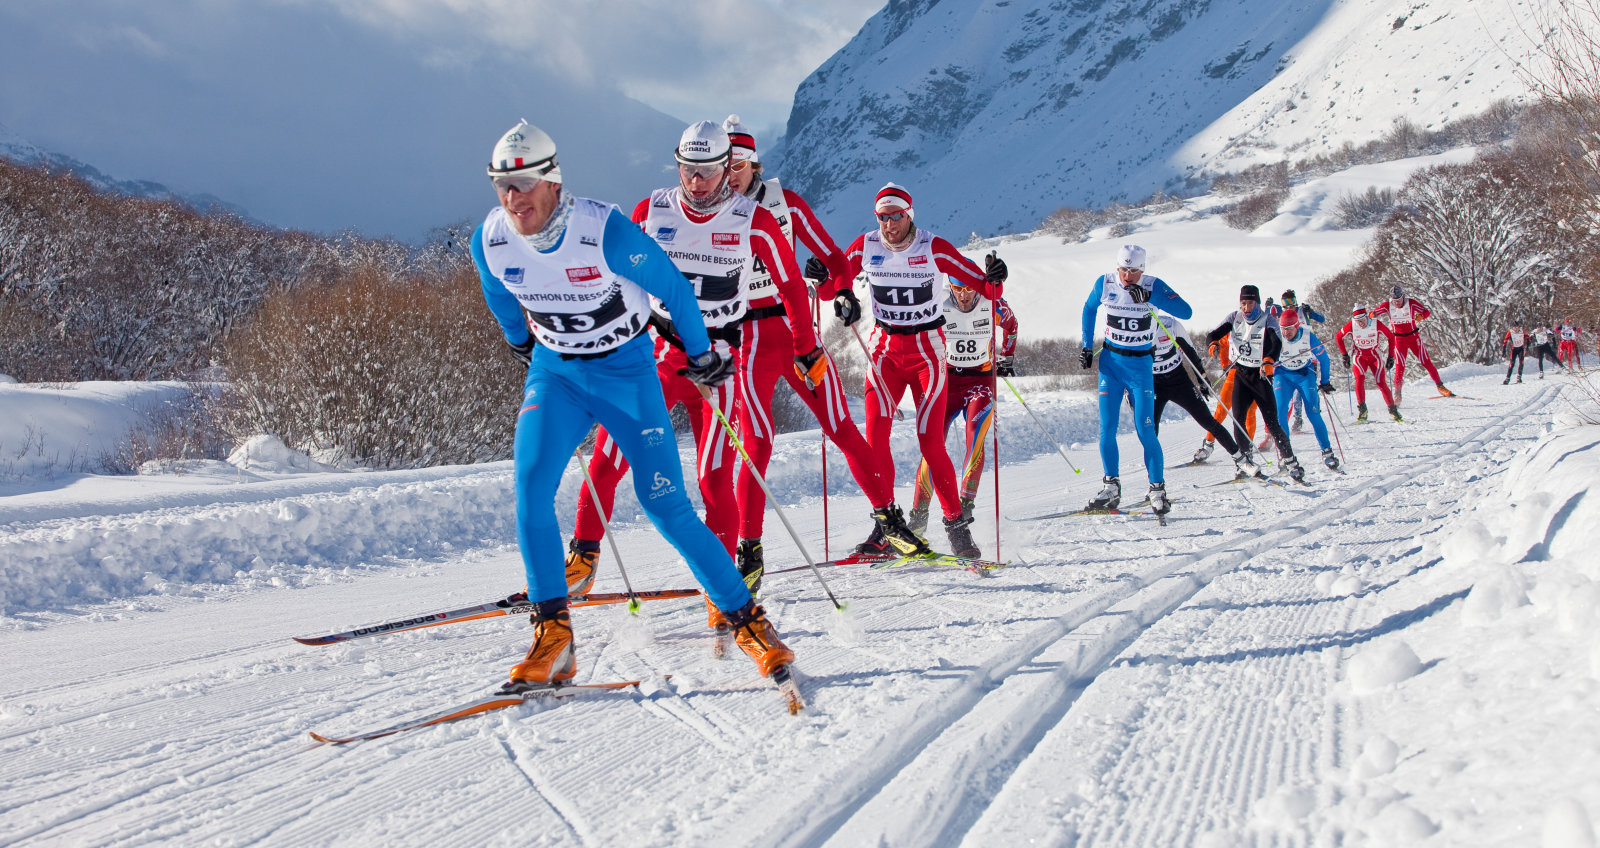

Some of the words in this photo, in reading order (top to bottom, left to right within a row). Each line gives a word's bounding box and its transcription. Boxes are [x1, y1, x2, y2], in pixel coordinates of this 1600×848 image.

[664, 250, 700, 262] ARATHON
[701, 254, 712, 263] DE
[563, 294, 577, 302] DE
[886, 288, 915, 305] 11
[881, 304, 938, 321] BESSANS
[1117, 318, 1139, 331] 16
[1111, 332, 1154, 343] BESSANS
[955, 339, 977, 354] 68
[352, 614, 436, 637] ROSSIGNOL
